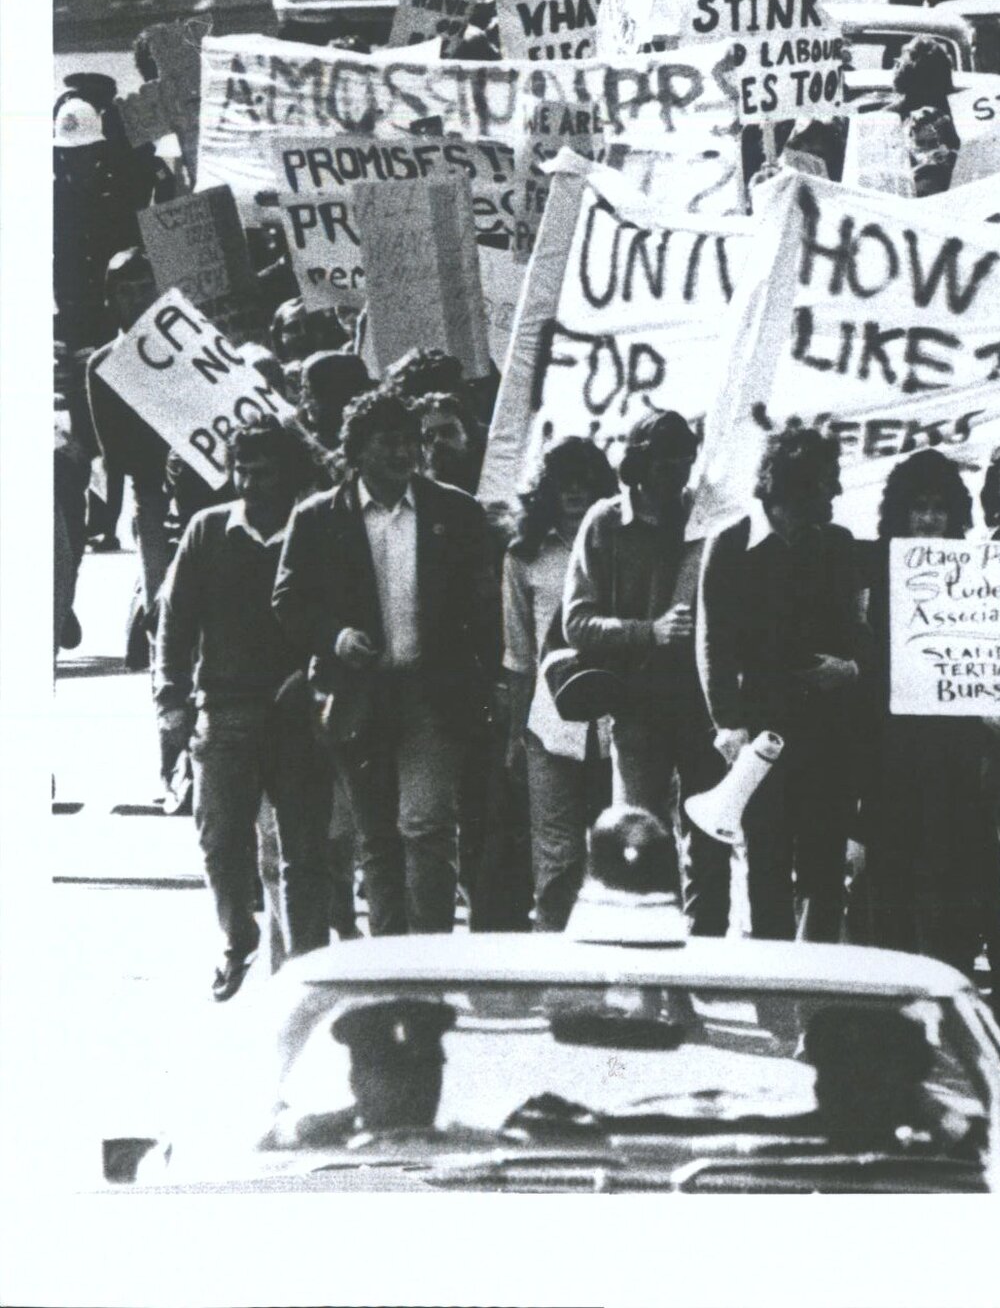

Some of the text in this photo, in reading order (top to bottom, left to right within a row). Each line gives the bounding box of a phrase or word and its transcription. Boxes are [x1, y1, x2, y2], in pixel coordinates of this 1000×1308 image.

[740, 73, 779, 115] ES
[136, 305, 205, 371] CA
[791, 304, 963, 394] LIKE
[903, 543, 971, 584] Otago
